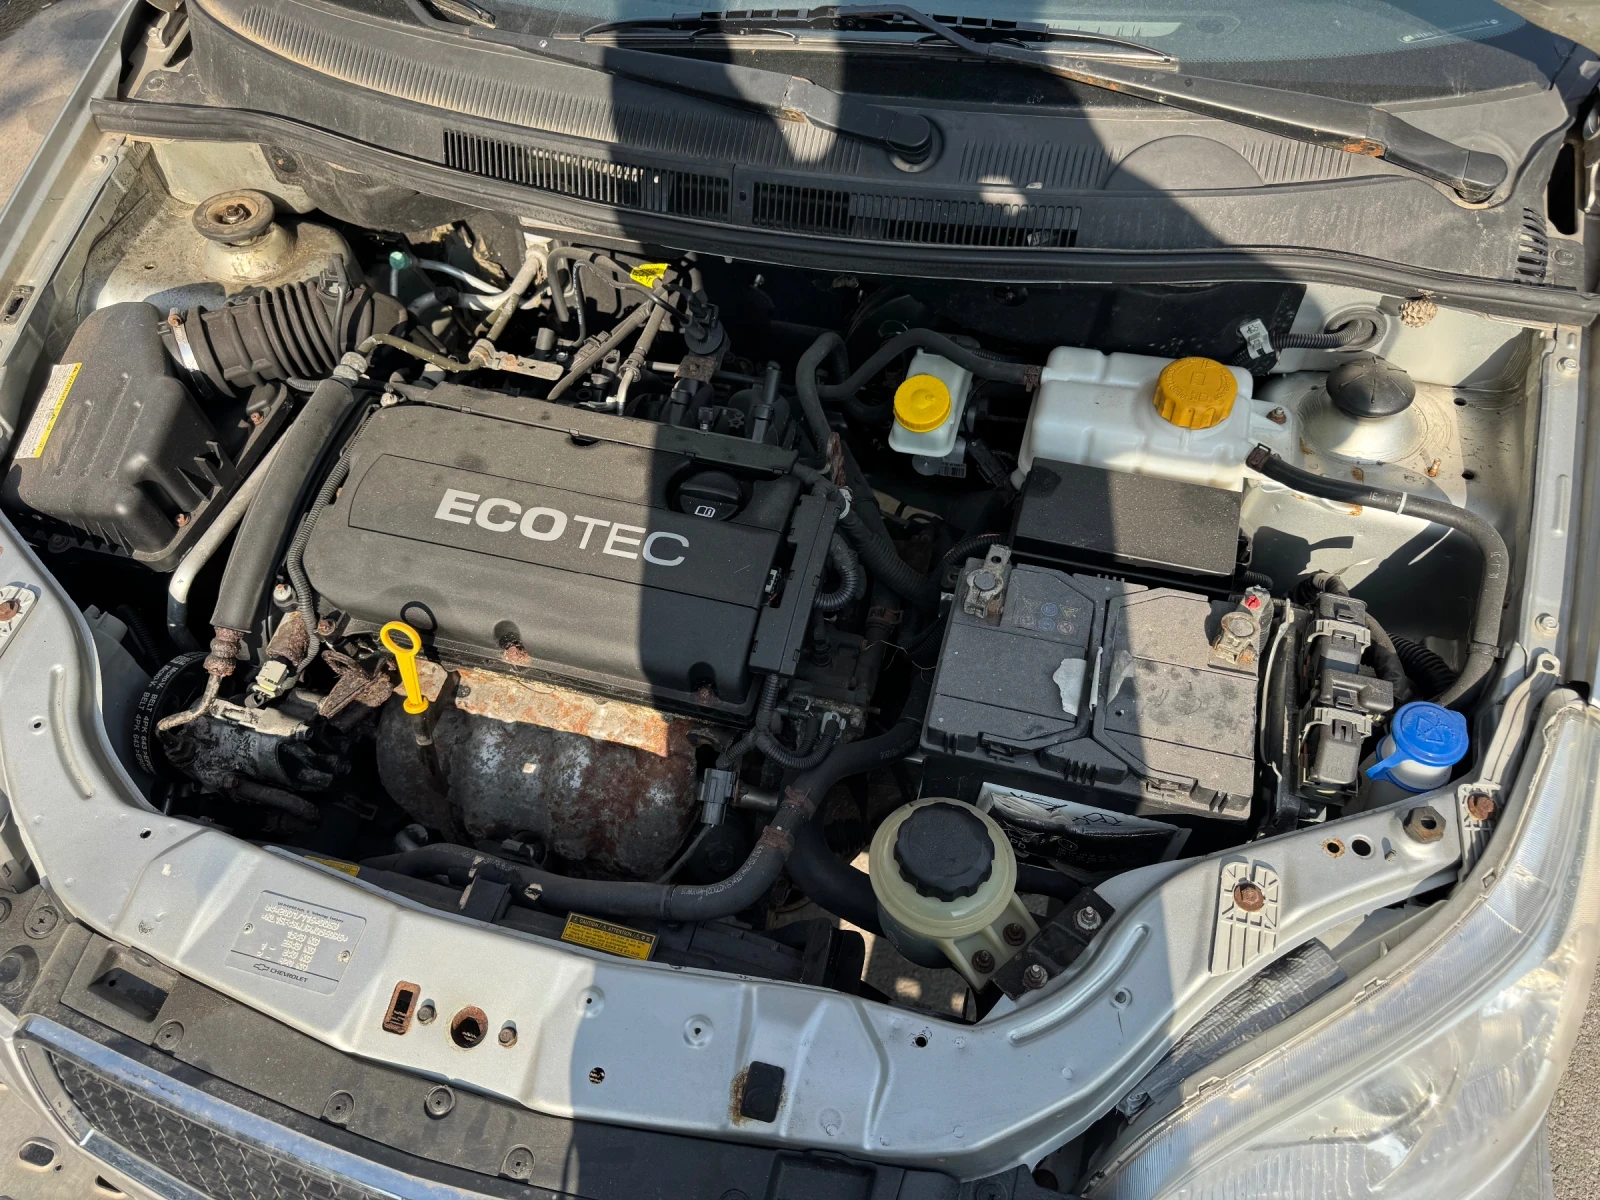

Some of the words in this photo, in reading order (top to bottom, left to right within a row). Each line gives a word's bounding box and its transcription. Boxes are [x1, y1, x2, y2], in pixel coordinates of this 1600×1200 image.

[434, 488, 690, 567] ECOTEC
[138, 691, 151, 711] BELT
[146, 693, 159, 713] BELT
[133, 713, 142, 732] 4PK
[141, 715, 150, 733] 4PK
[269, 967, 309, 983] CHEVROLET
